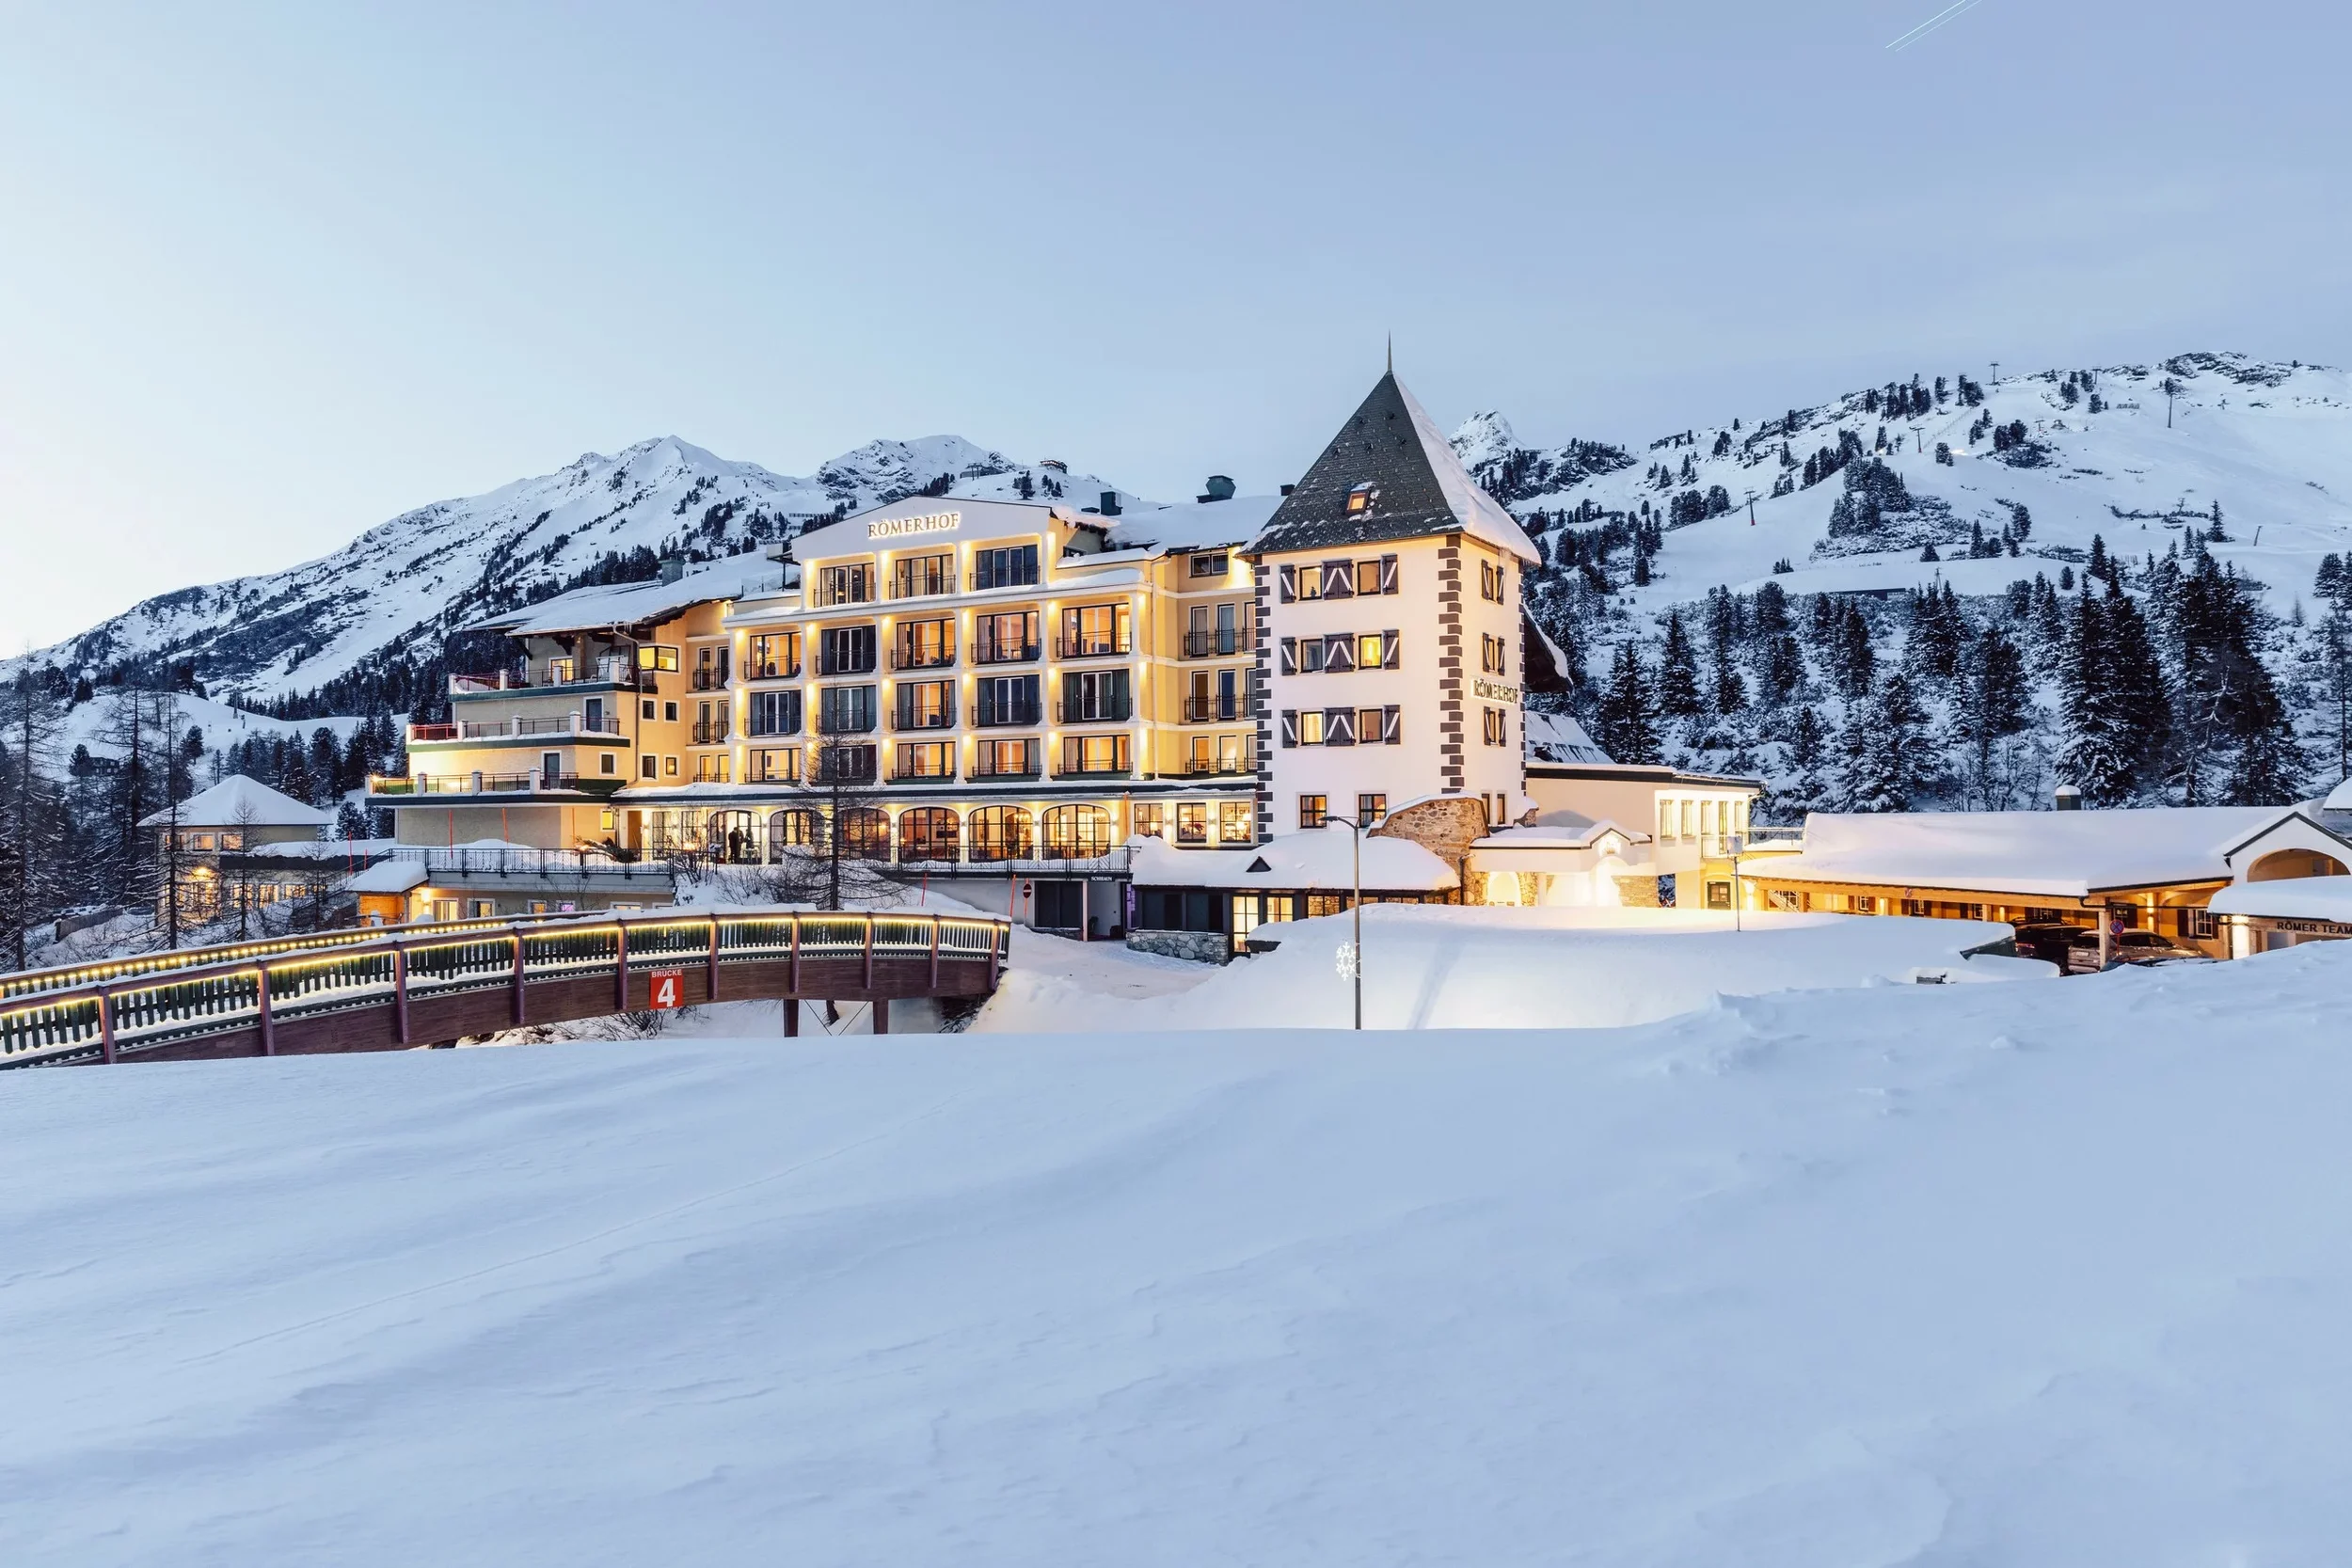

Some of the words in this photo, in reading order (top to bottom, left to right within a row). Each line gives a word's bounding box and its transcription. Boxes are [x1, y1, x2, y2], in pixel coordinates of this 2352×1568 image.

[867, 512, 959, 537] RÖMERHOF
[1473, 678, 1518, 704] RÖMERHOF
[2277, 921, 2317, 932] RÖMER
[658, 978, 675, 1007] 4
